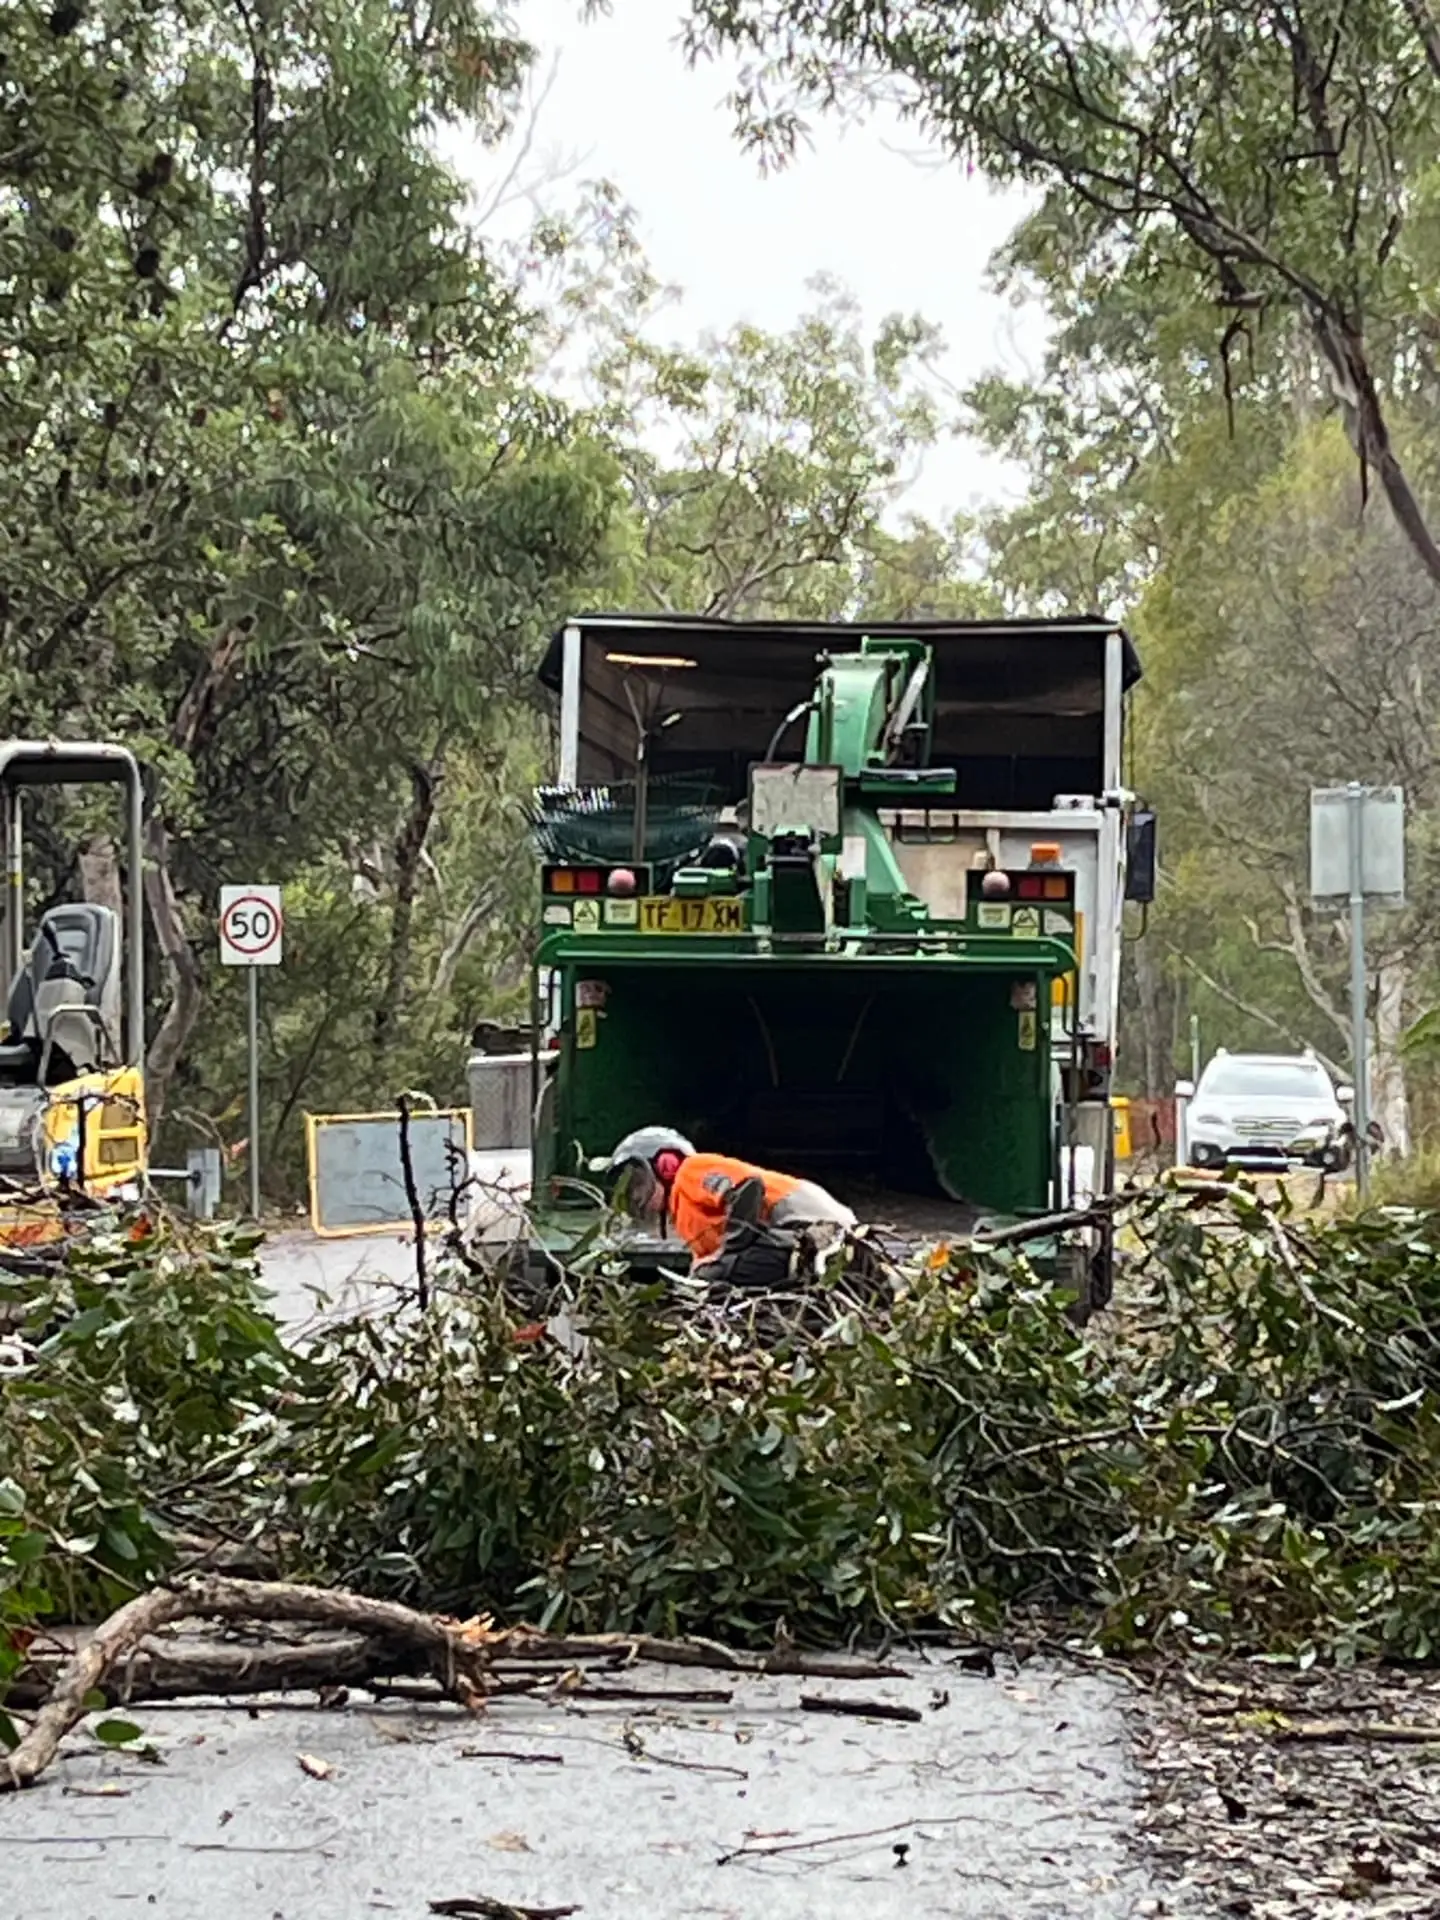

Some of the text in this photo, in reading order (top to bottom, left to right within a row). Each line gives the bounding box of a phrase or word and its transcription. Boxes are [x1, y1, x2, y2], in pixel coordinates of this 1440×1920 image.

[232, 911, 269, 939] 50
[644, 903, 670, 928] TF
[681, 903, 704, 928] 17
